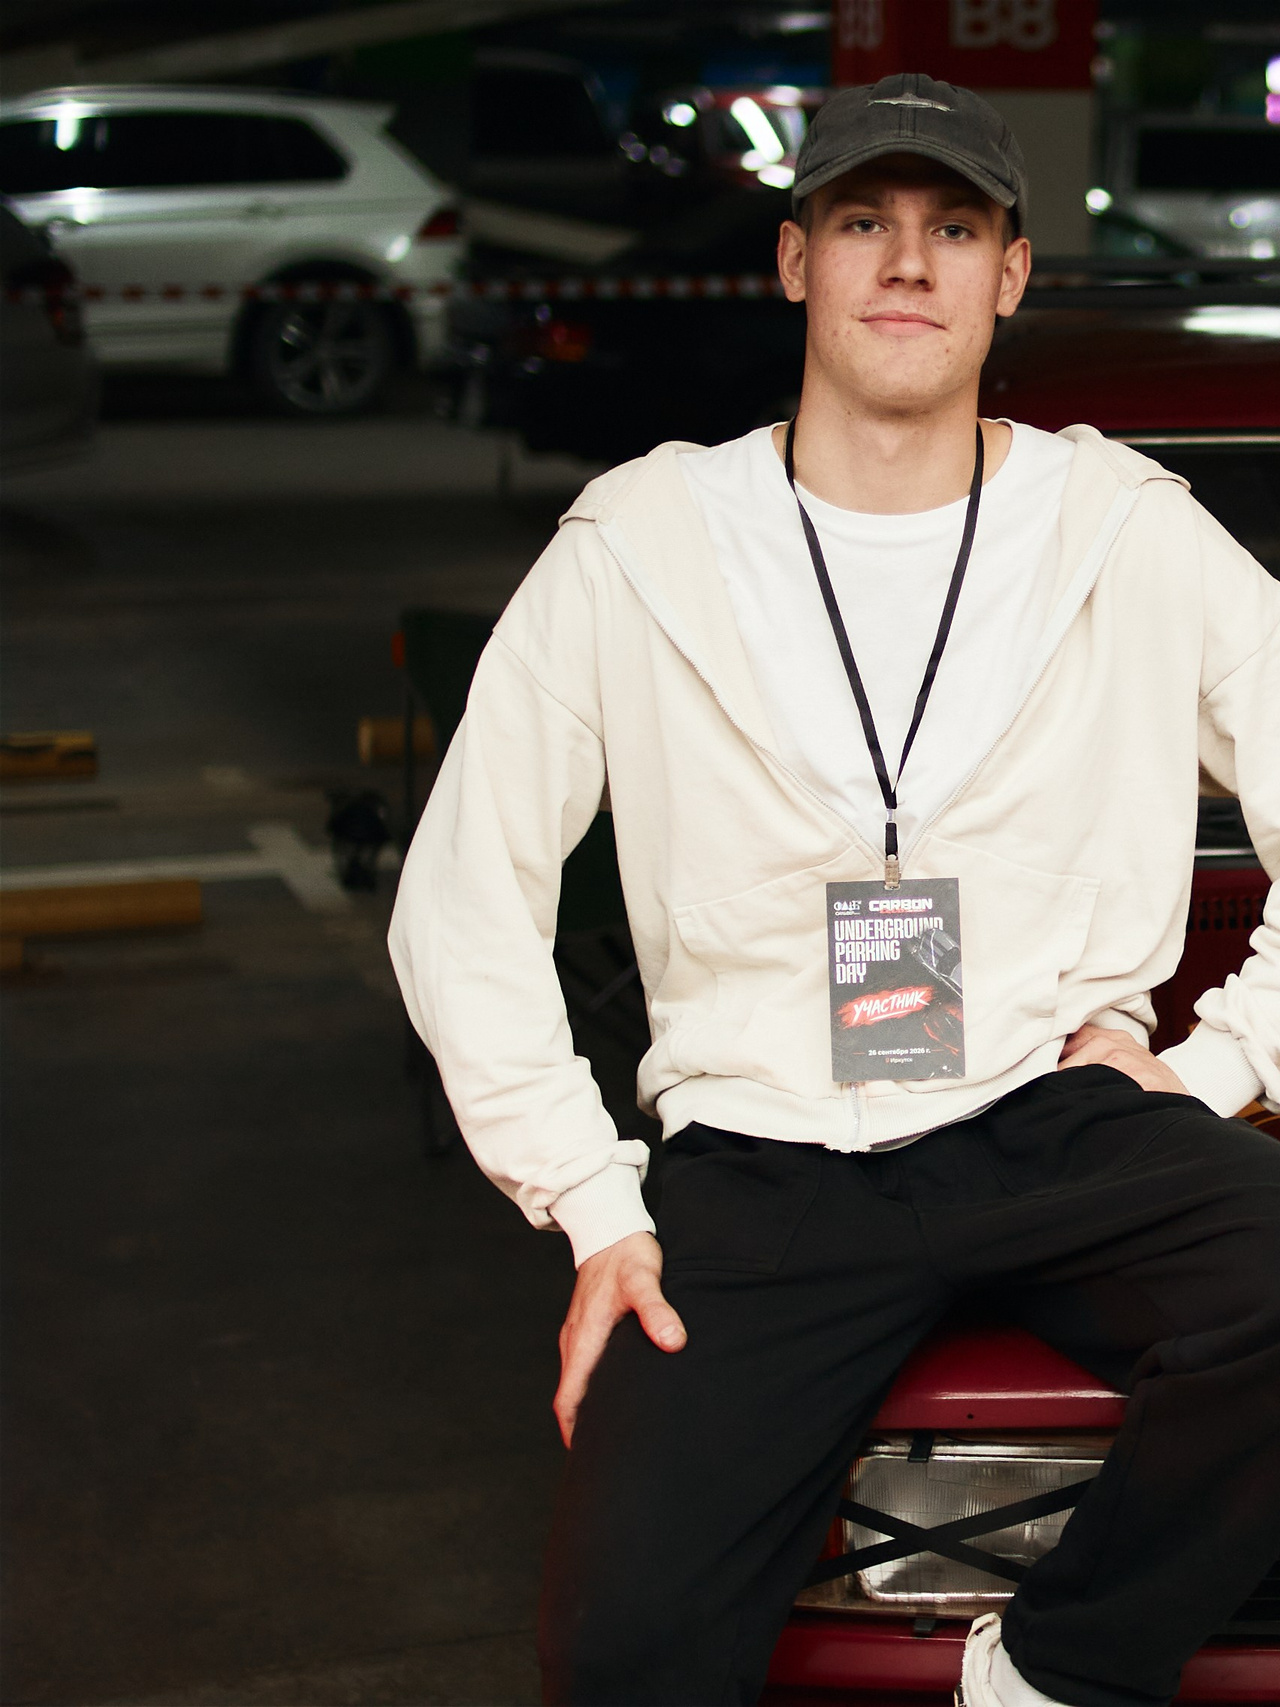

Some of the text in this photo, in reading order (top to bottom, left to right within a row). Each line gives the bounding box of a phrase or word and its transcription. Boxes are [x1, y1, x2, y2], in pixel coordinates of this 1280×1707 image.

[949, 0, 1060, 51] B8
[868, 898, 933, 912] CARBON
[834, 917, 944, 941] UNDERGROUND
[835, 940, 901, 963] PARKING
[835, 963, 867, 984] DAY
[851, 990, 930, 1026] УЧАСТНИК
[878, 1048, 909, 1058] сентября
